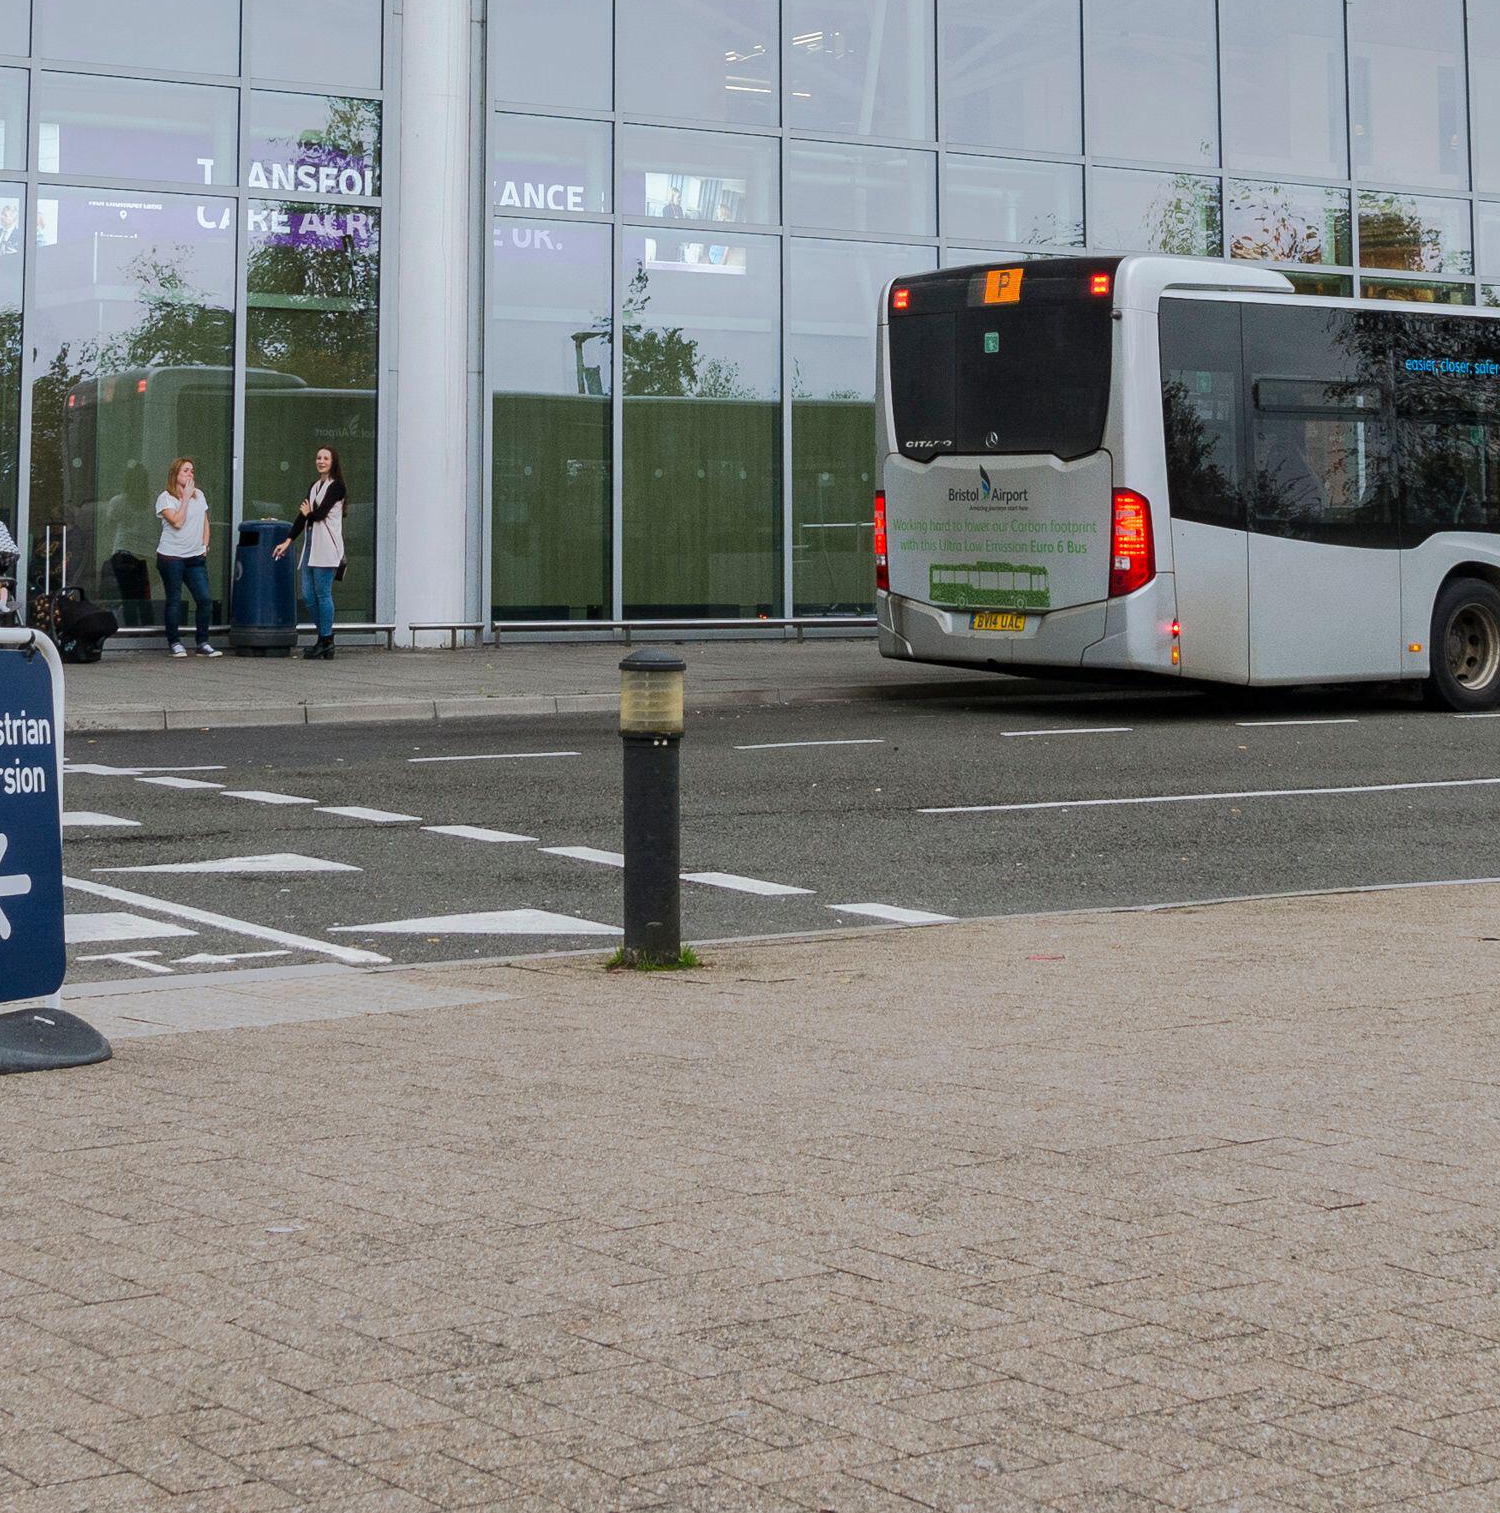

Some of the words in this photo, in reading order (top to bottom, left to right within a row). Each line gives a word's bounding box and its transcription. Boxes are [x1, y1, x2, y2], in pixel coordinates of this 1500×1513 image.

[997, 272, 1010, 298] P
[1475, 359, 1499, 375] safer
[949, 488, 979, 502] Bristol
[991, 488, 1028, 505] Airport
[893, 520, 927, 534] Working
[929, 519, 949, 532] hard
[964, 519, 989, 532] lower
[992, 522, 1009, 532] our
[1011, 520, 1047, 533] Carbon
[1049, 519, 1098, 536] footprint
[900, 540, 919, 552] with
[920, 539, 937, 552] this
[964, 541, 984, 552] Low
[986, 540, 1028, 553] Emission
[1030, 541, 1054, 553] Euro
[1056, 541, 1064, 553] 6
[1067, 541, 1088, 553] Bus
[1001, 615, 1023, 629] UAC
